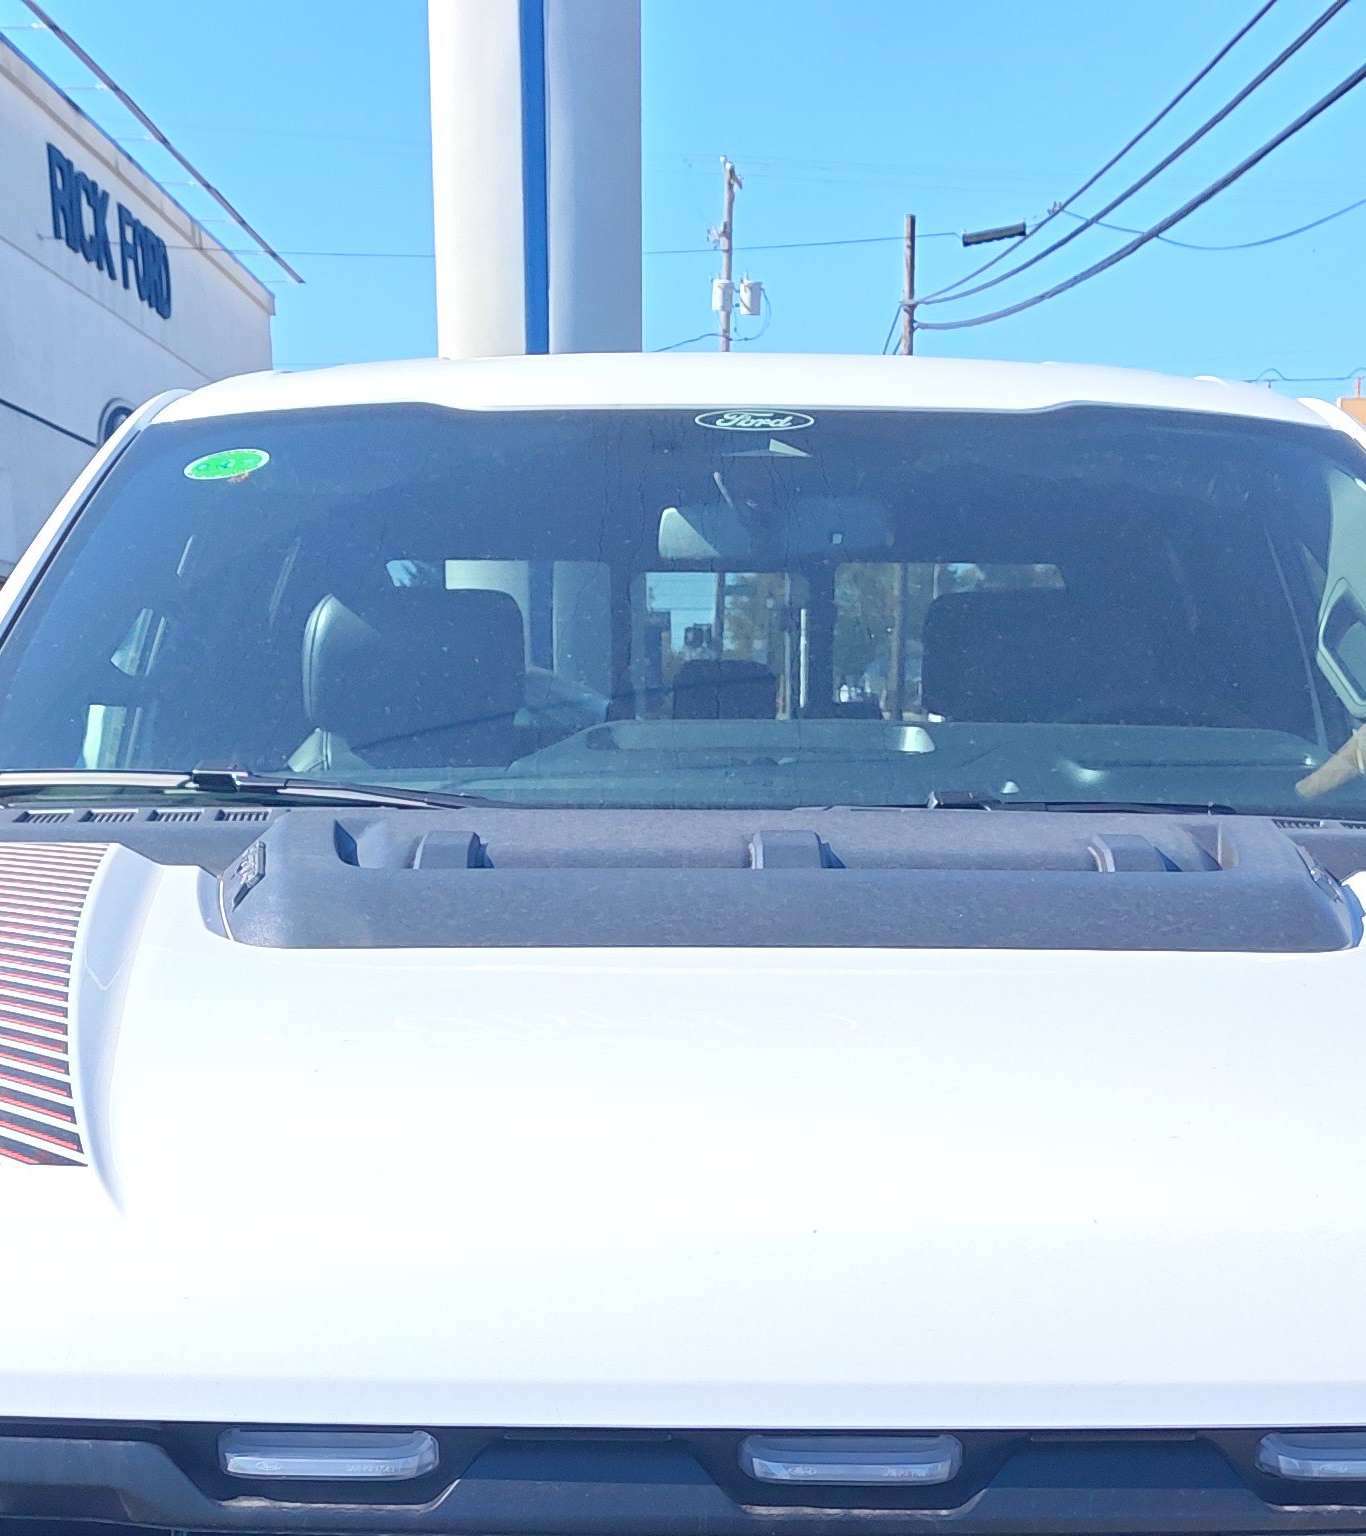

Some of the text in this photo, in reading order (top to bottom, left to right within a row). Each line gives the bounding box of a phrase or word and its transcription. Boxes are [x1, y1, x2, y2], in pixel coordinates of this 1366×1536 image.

[47, 142, 172, 320] RICK FORD
[715, 412, 794, 428] Ford
